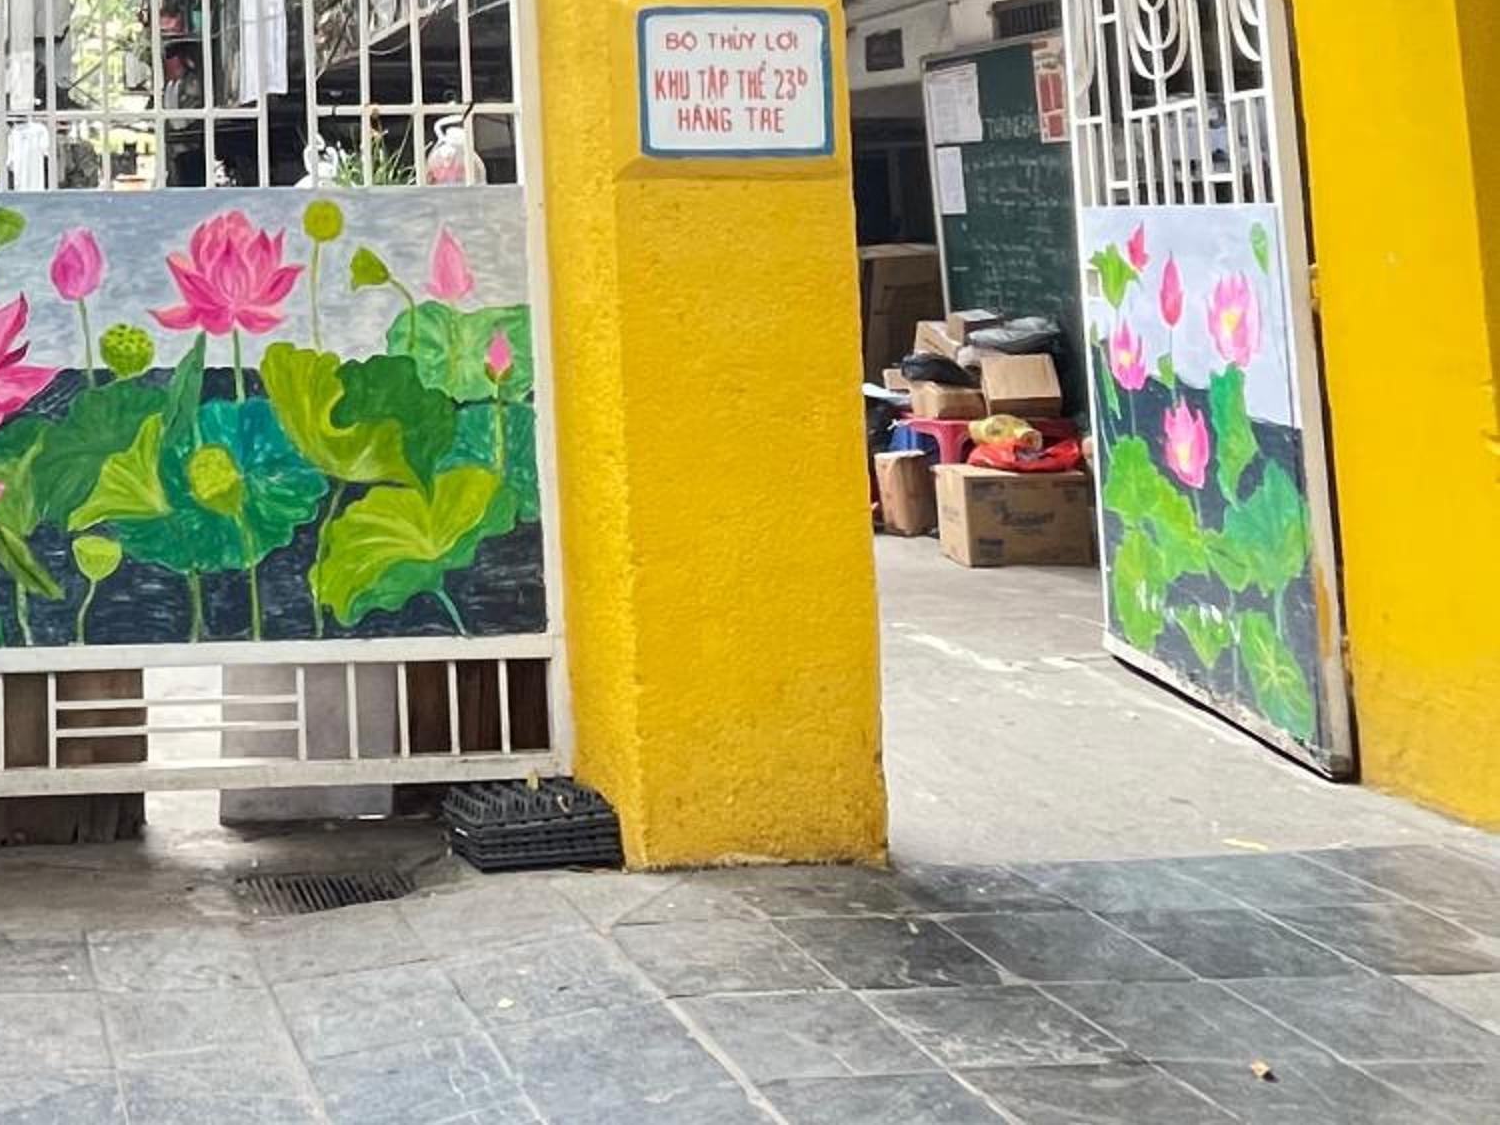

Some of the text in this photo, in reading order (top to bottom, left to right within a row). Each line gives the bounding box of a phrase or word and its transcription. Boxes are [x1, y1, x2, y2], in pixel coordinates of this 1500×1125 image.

[654, 68, 691, 101] KHU
[697, 64, 730, 104] TẬP
[736, 60, 767, 100] THỂ
[744, 106, 785, 133] TRE
